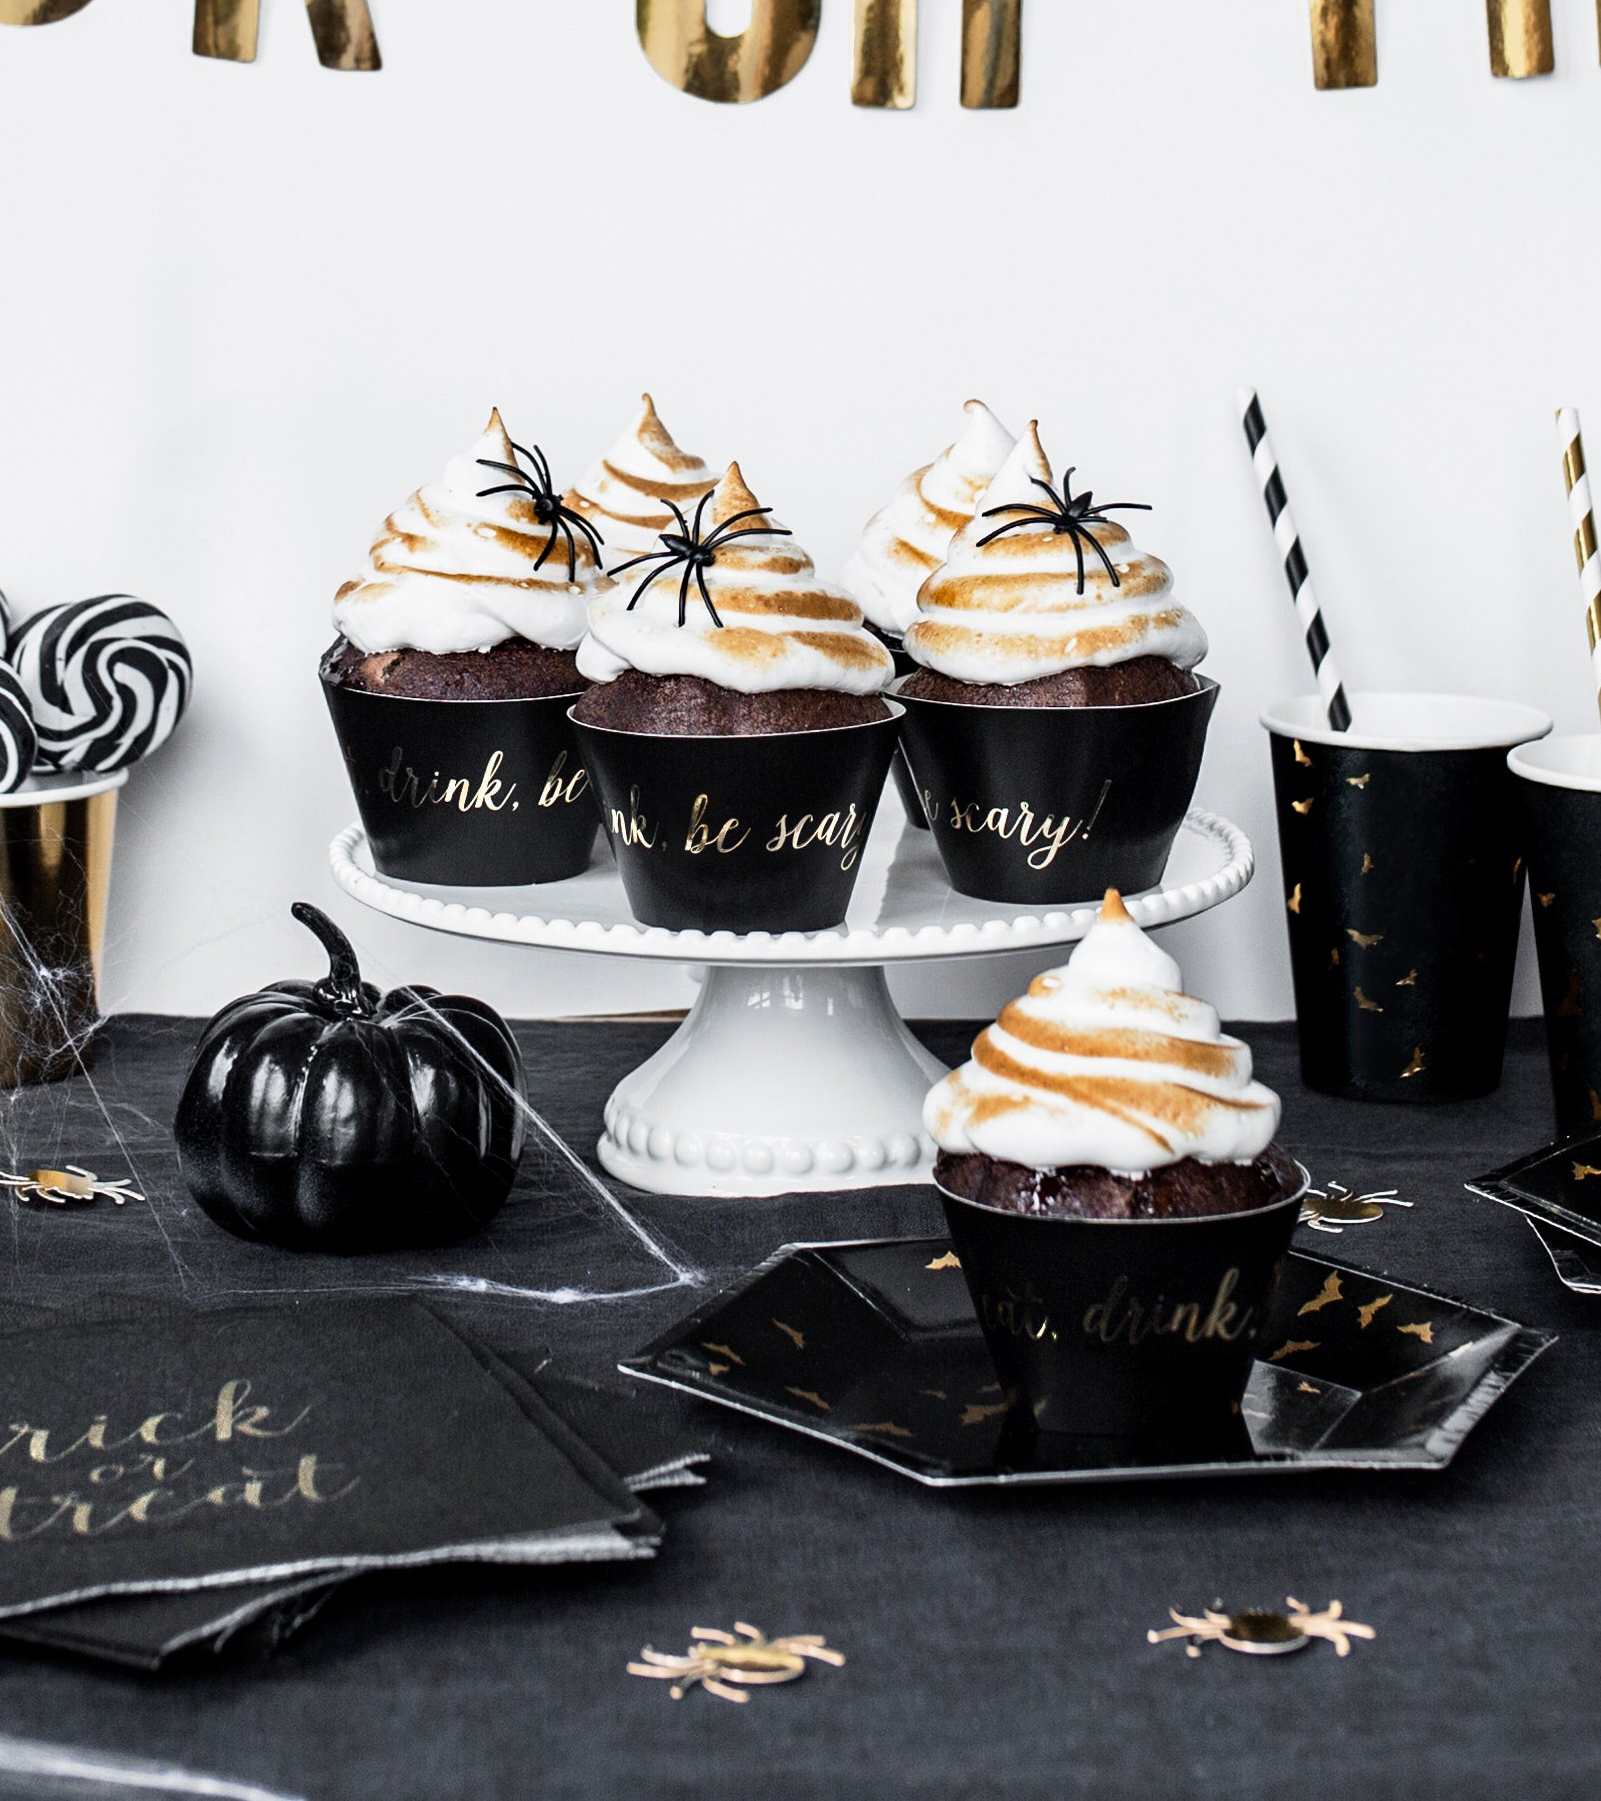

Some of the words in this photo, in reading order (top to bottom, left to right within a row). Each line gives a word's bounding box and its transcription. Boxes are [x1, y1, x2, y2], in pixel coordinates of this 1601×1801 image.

[684, 793, 752, 854] be
[950, 779, 1112, 870] scary!
[90, 1454, 196, 1486] or
